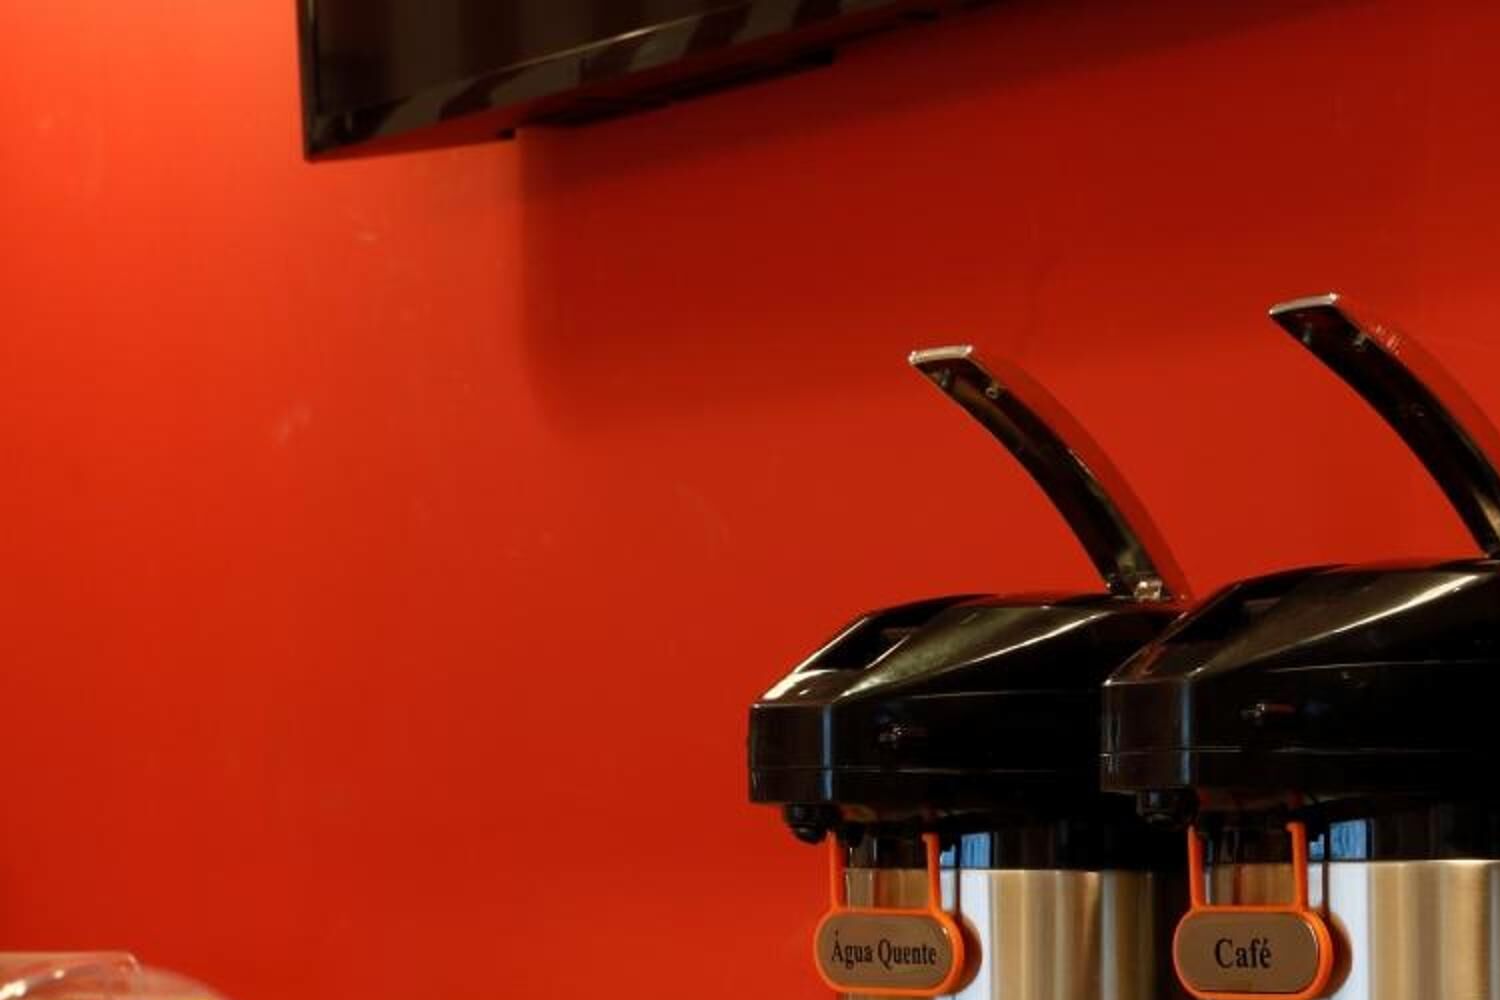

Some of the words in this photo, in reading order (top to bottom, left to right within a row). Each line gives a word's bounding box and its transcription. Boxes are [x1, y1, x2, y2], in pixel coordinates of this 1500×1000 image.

[831, 928, 874, 970] Água
[877, 938, 938, 971] Quente
[1214, 938, 1272, 969] Café
